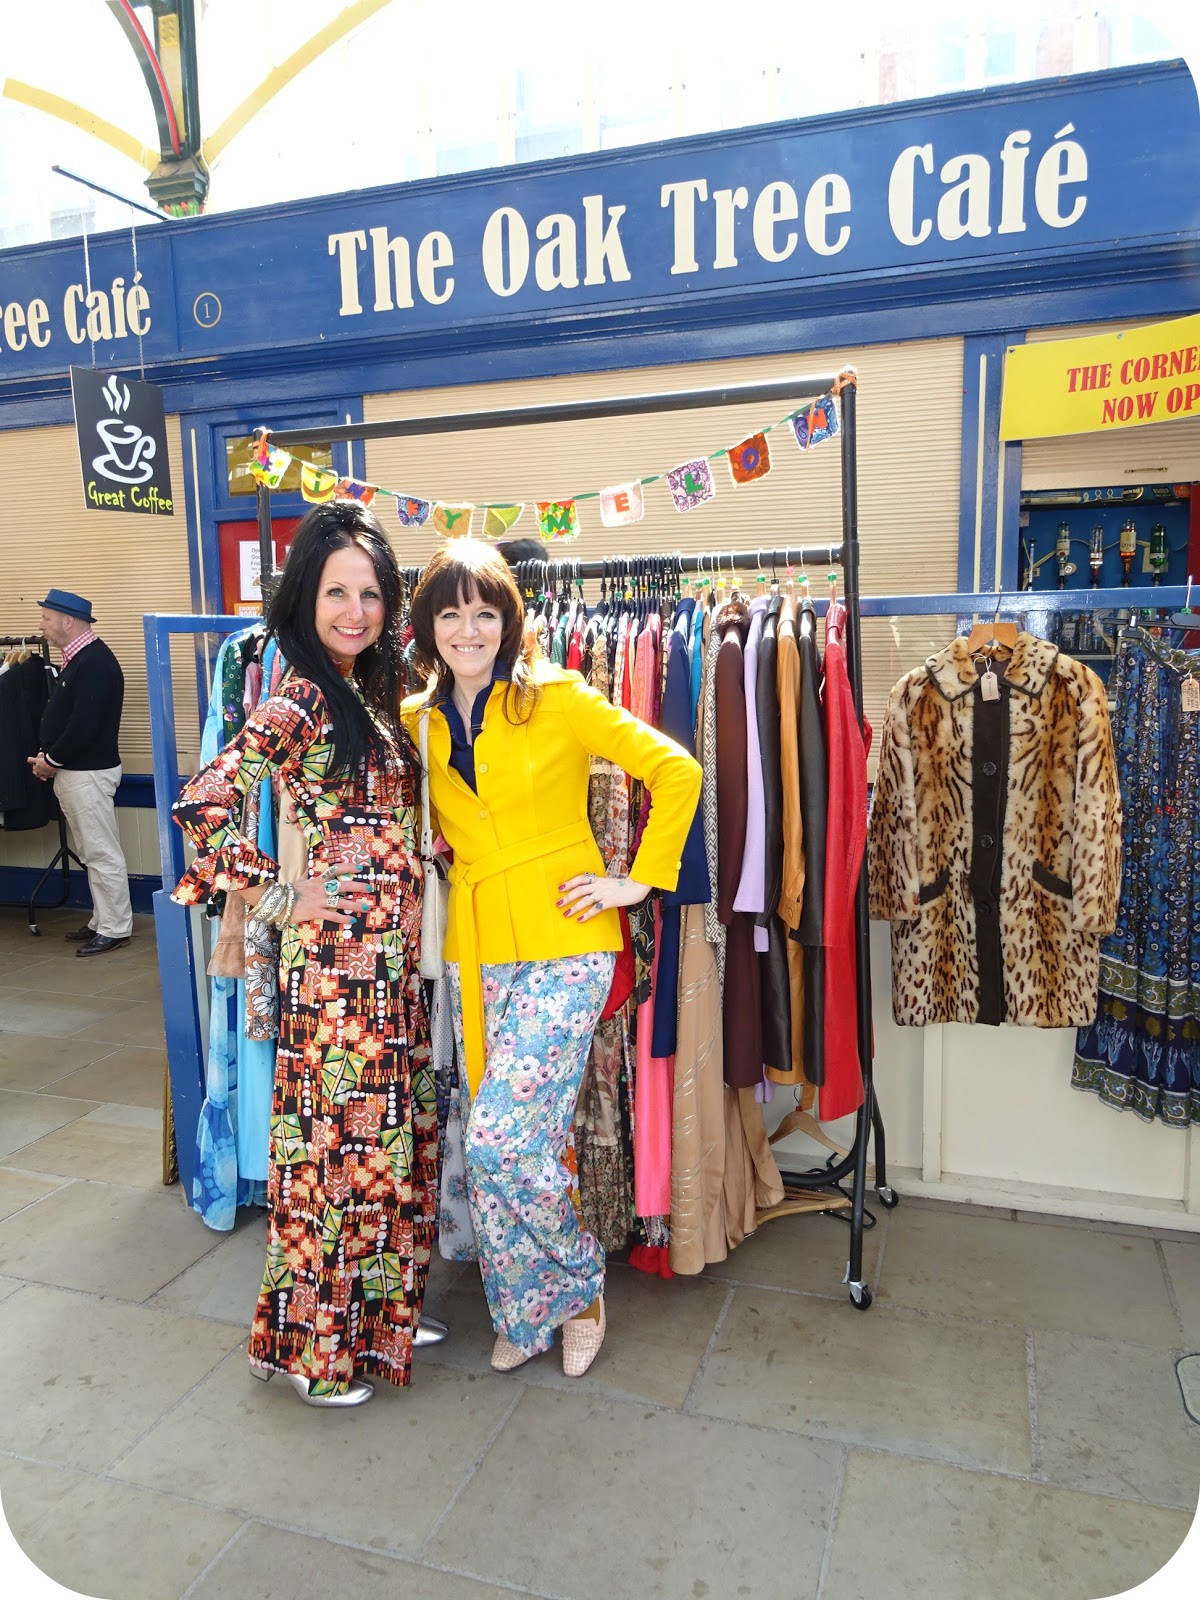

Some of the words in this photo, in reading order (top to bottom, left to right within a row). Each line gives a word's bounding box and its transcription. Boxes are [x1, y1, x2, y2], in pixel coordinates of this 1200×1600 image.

[328, 226, 455, 317] The
[482, 194, 632, 297] Oak
[661, 172, 852, 276] Tree
[888, 122, 1089, 246] Café
[0, 298, 51, 352] ee
[63, 271, 151, 345] Café
[203, 302, 211, 319] 1
[1067, 363, 1112, 393] THE
[1120, 345, 1200, 386] CORNE
[1101, 391, 1159, 424] NOW
[88, 481, 126, 508] Great
[130, 485, 173, 514] Coffee
